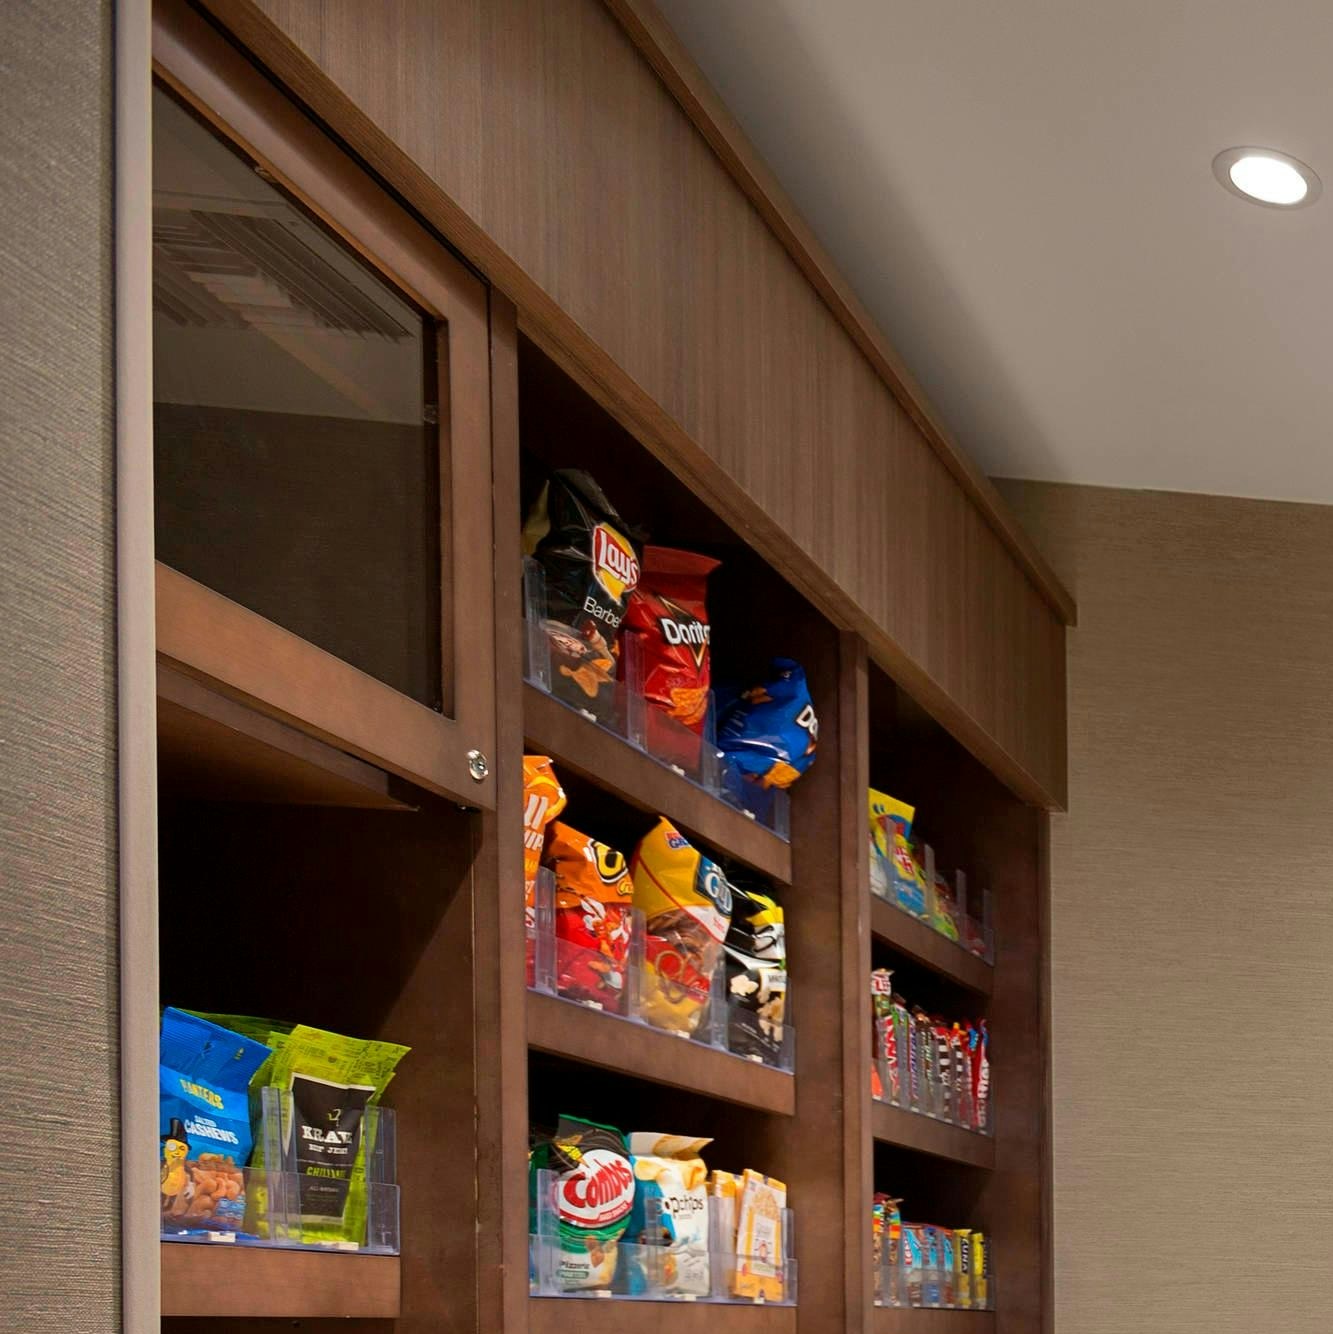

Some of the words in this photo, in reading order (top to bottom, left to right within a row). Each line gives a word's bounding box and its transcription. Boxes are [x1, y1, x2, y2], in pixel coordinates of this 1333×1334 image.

[599, 531, 639, 584] Lay's
[584, 596, 621, 629] Barbe
[184, 1119, 239, 1145] CASHEWS
